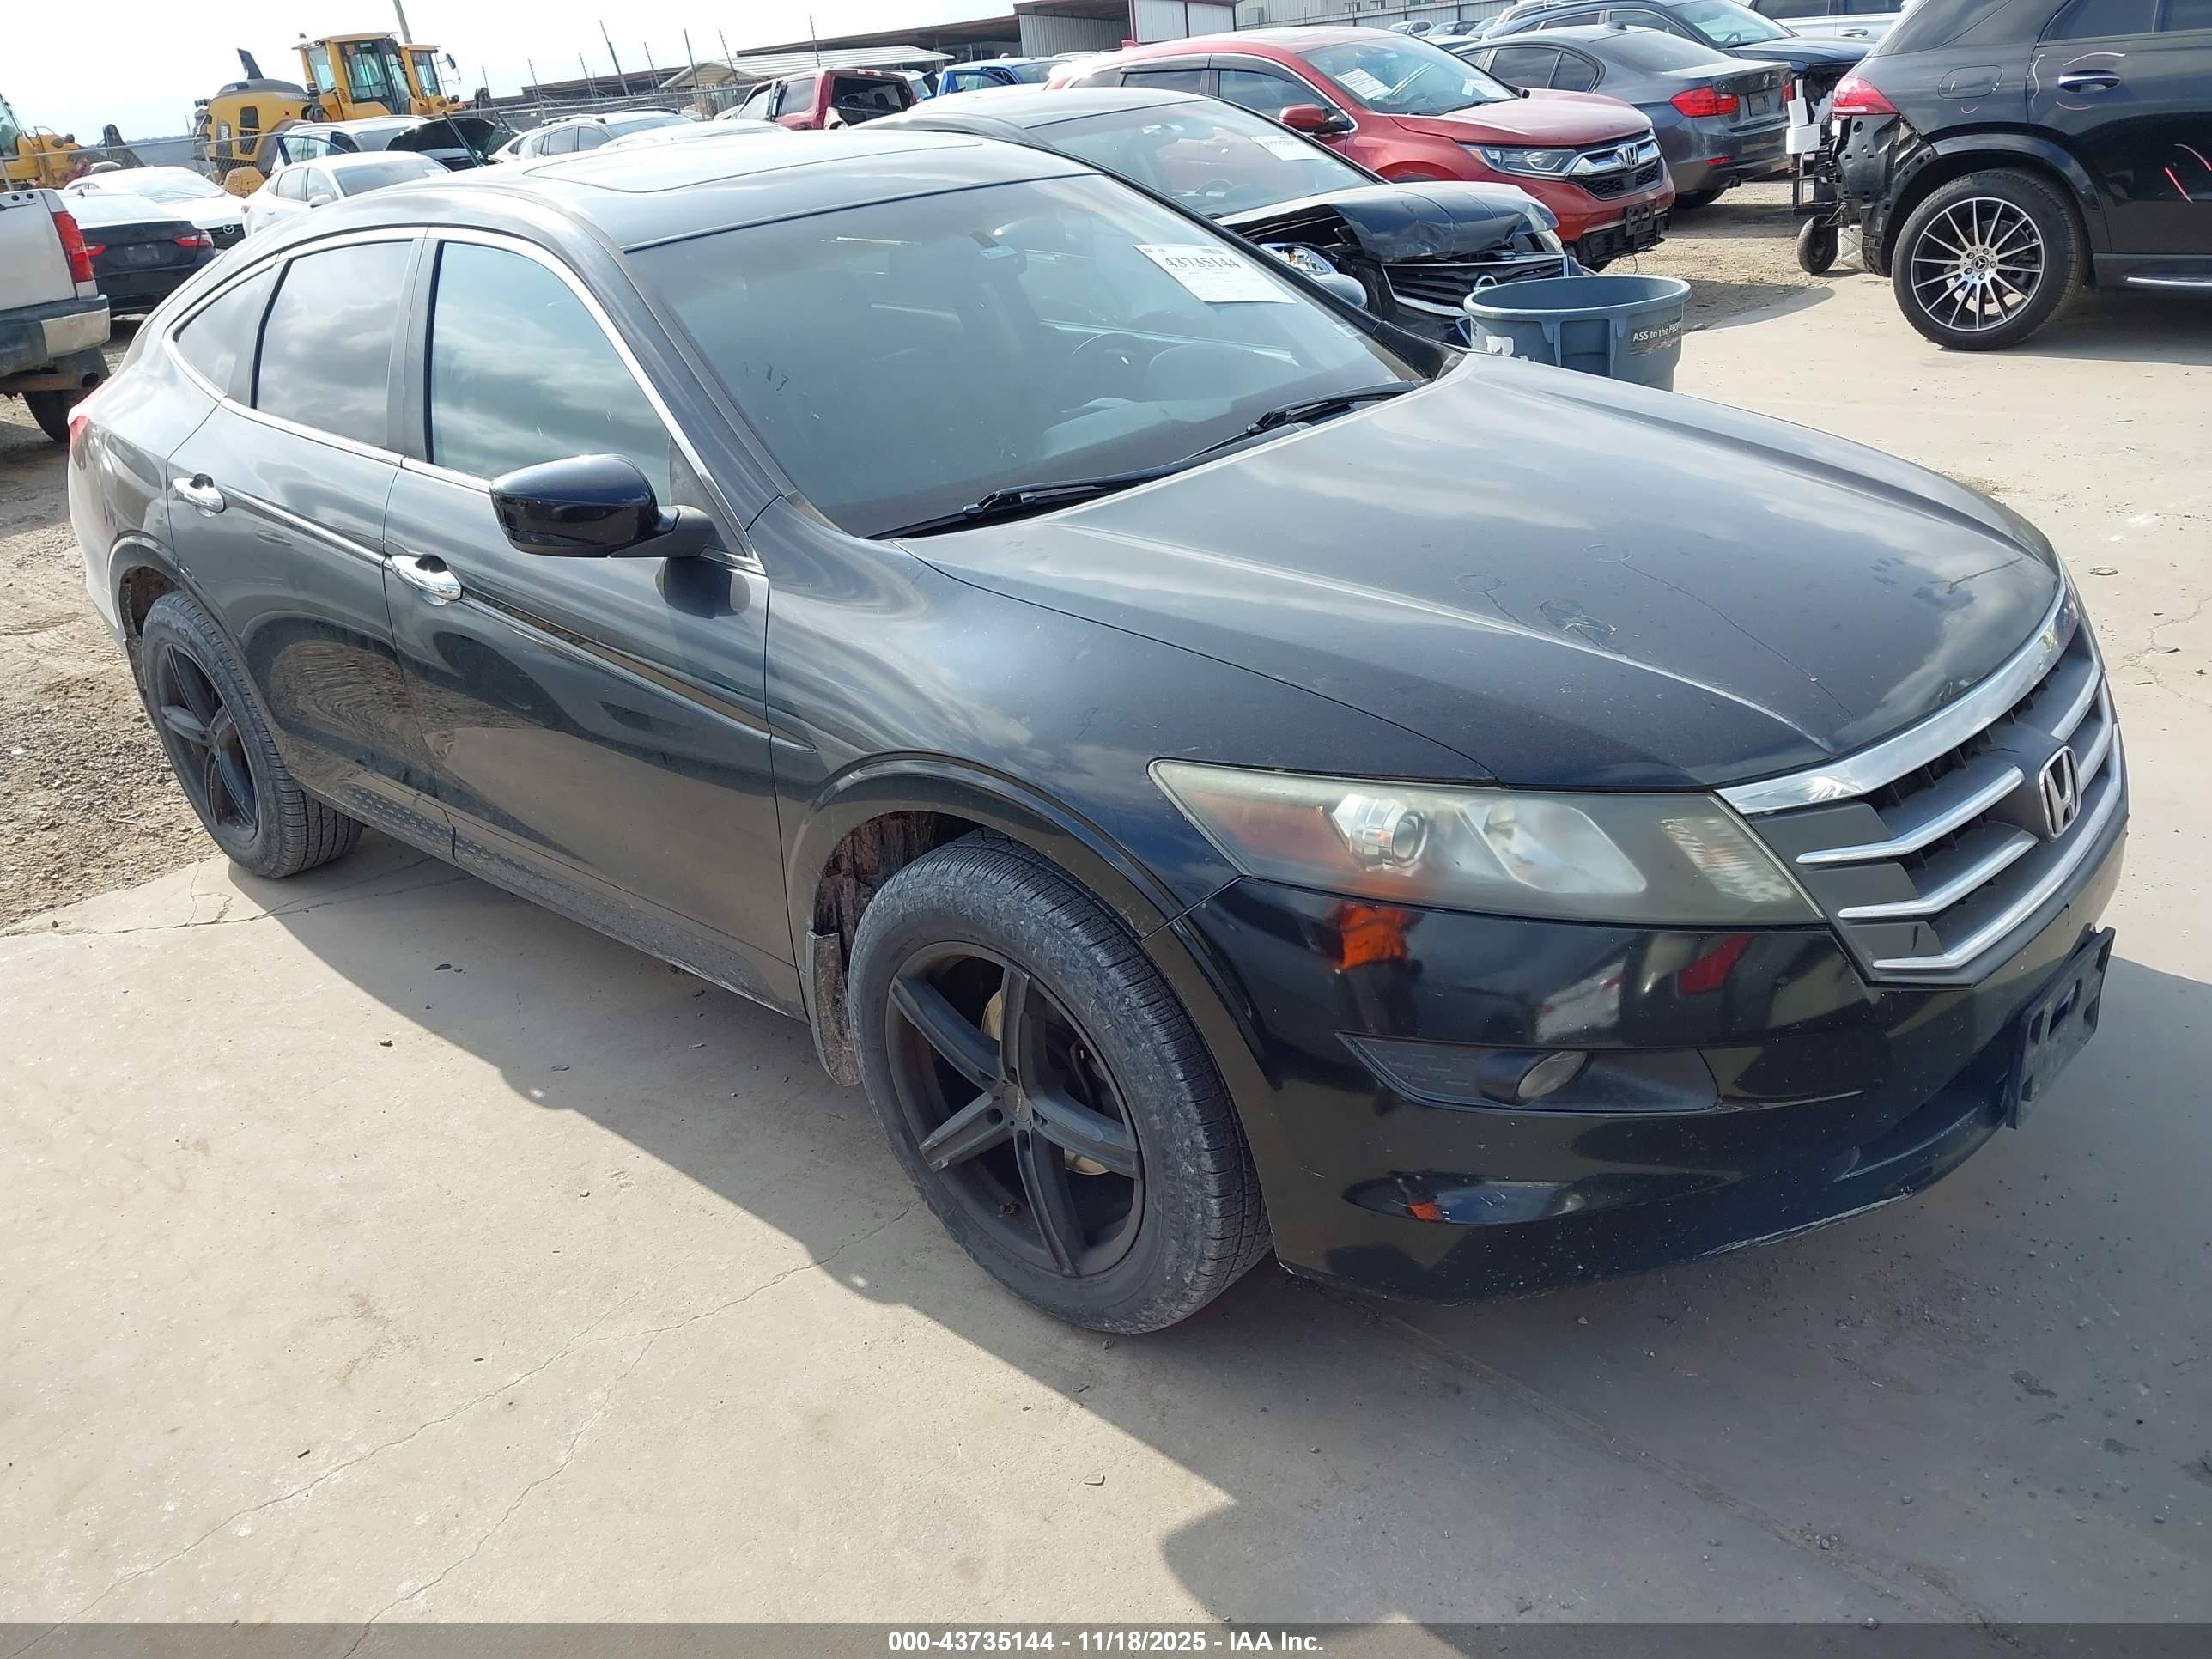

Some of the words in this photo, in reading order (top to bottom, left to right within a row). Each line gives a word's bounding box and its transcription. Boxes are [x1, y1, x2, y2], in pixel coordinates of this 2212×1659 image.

[1164, 257, 1242, 269] 43735144
[1632, 331, 1649, 343] ASS
[1650, 330, 1658, 339] to
[1659, 325, 1668, 337] the
